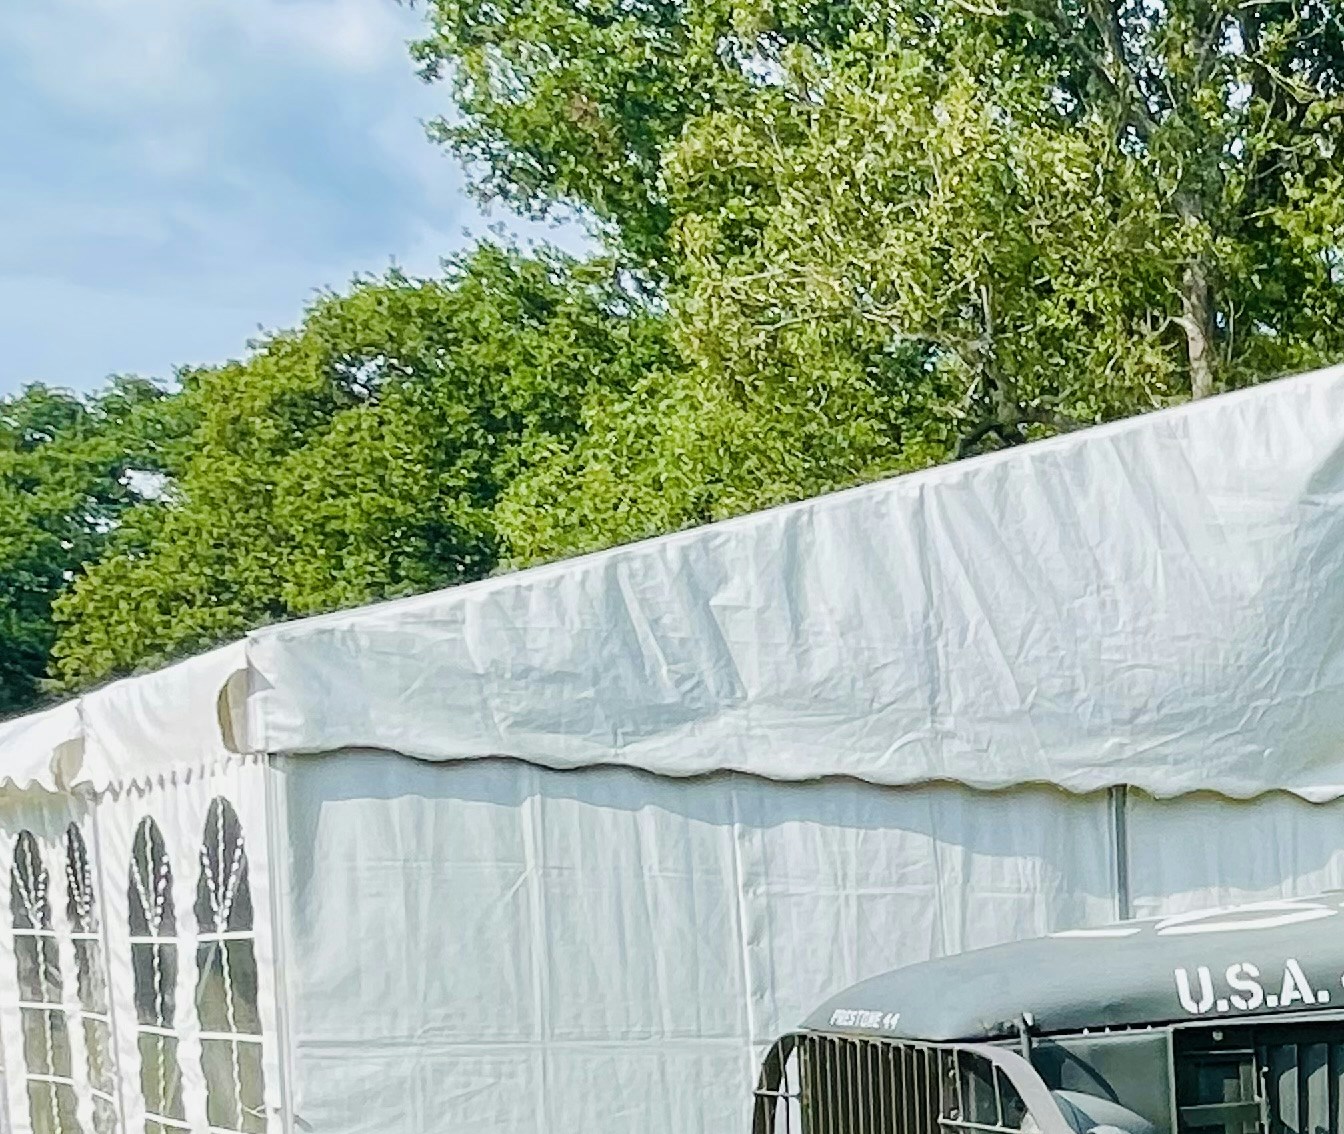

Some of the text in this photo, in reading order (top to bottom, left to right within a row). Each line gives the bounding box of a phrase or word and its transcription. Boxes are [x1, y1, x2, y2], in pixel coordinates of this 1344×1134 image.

[1173, 957, 1331, 1015] U.S.A.
[829, 1008, 900, 1030] PRESTONE 44
